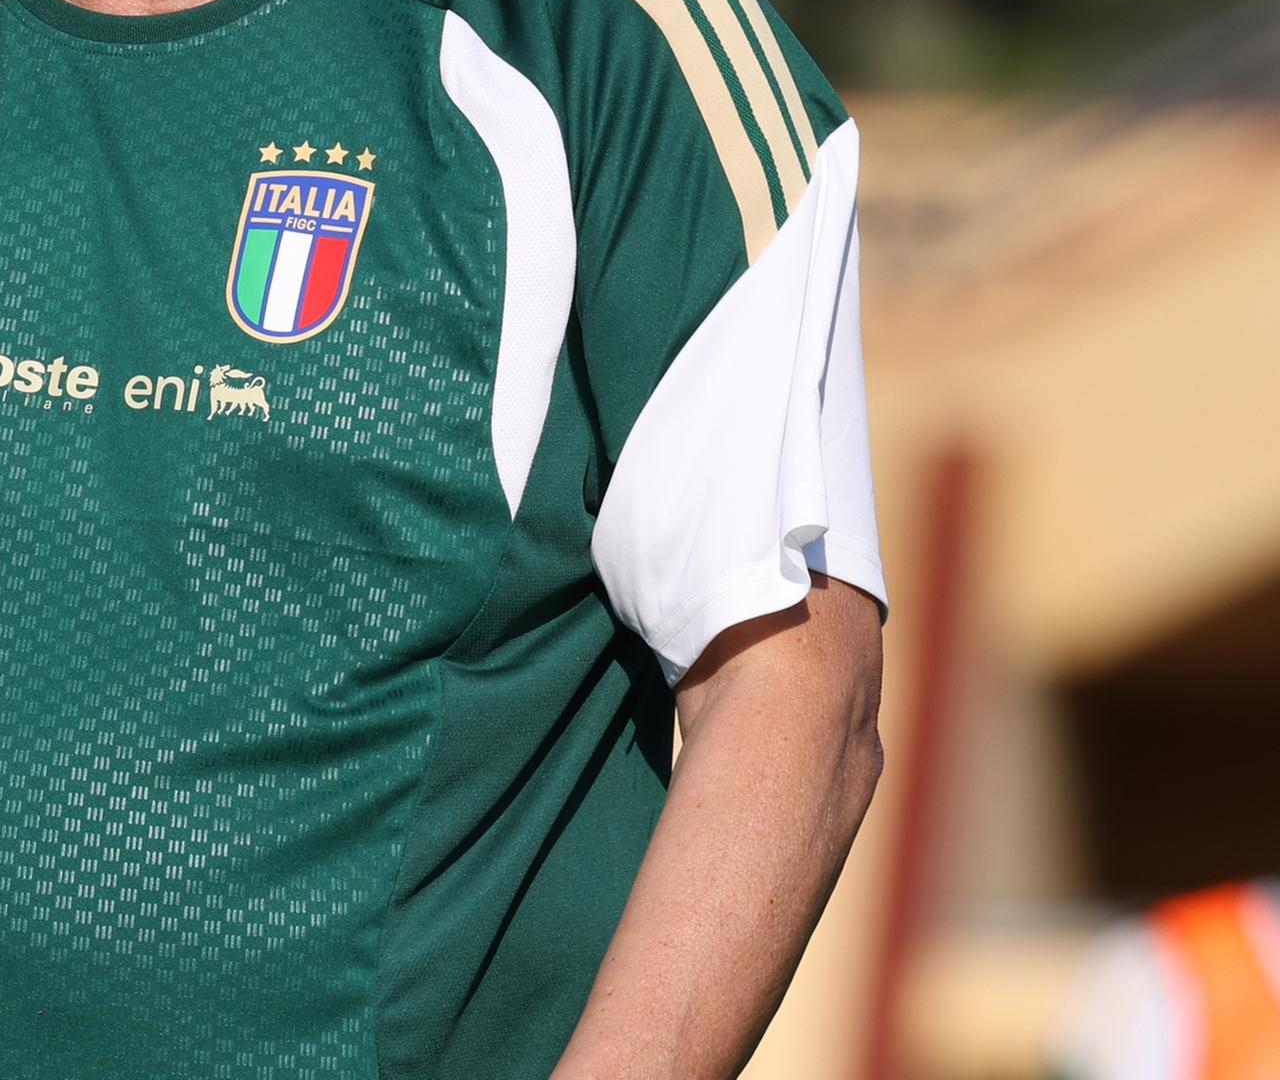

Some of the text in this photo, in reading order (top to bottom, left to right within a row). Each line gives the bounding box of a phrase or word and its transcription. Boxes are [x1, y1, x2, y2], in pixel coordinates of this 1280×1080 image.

[253, 183, 356, 222] ITALIA
[285, 216, 317, 231] FIGC
[123, 365, 204, 412] eni
